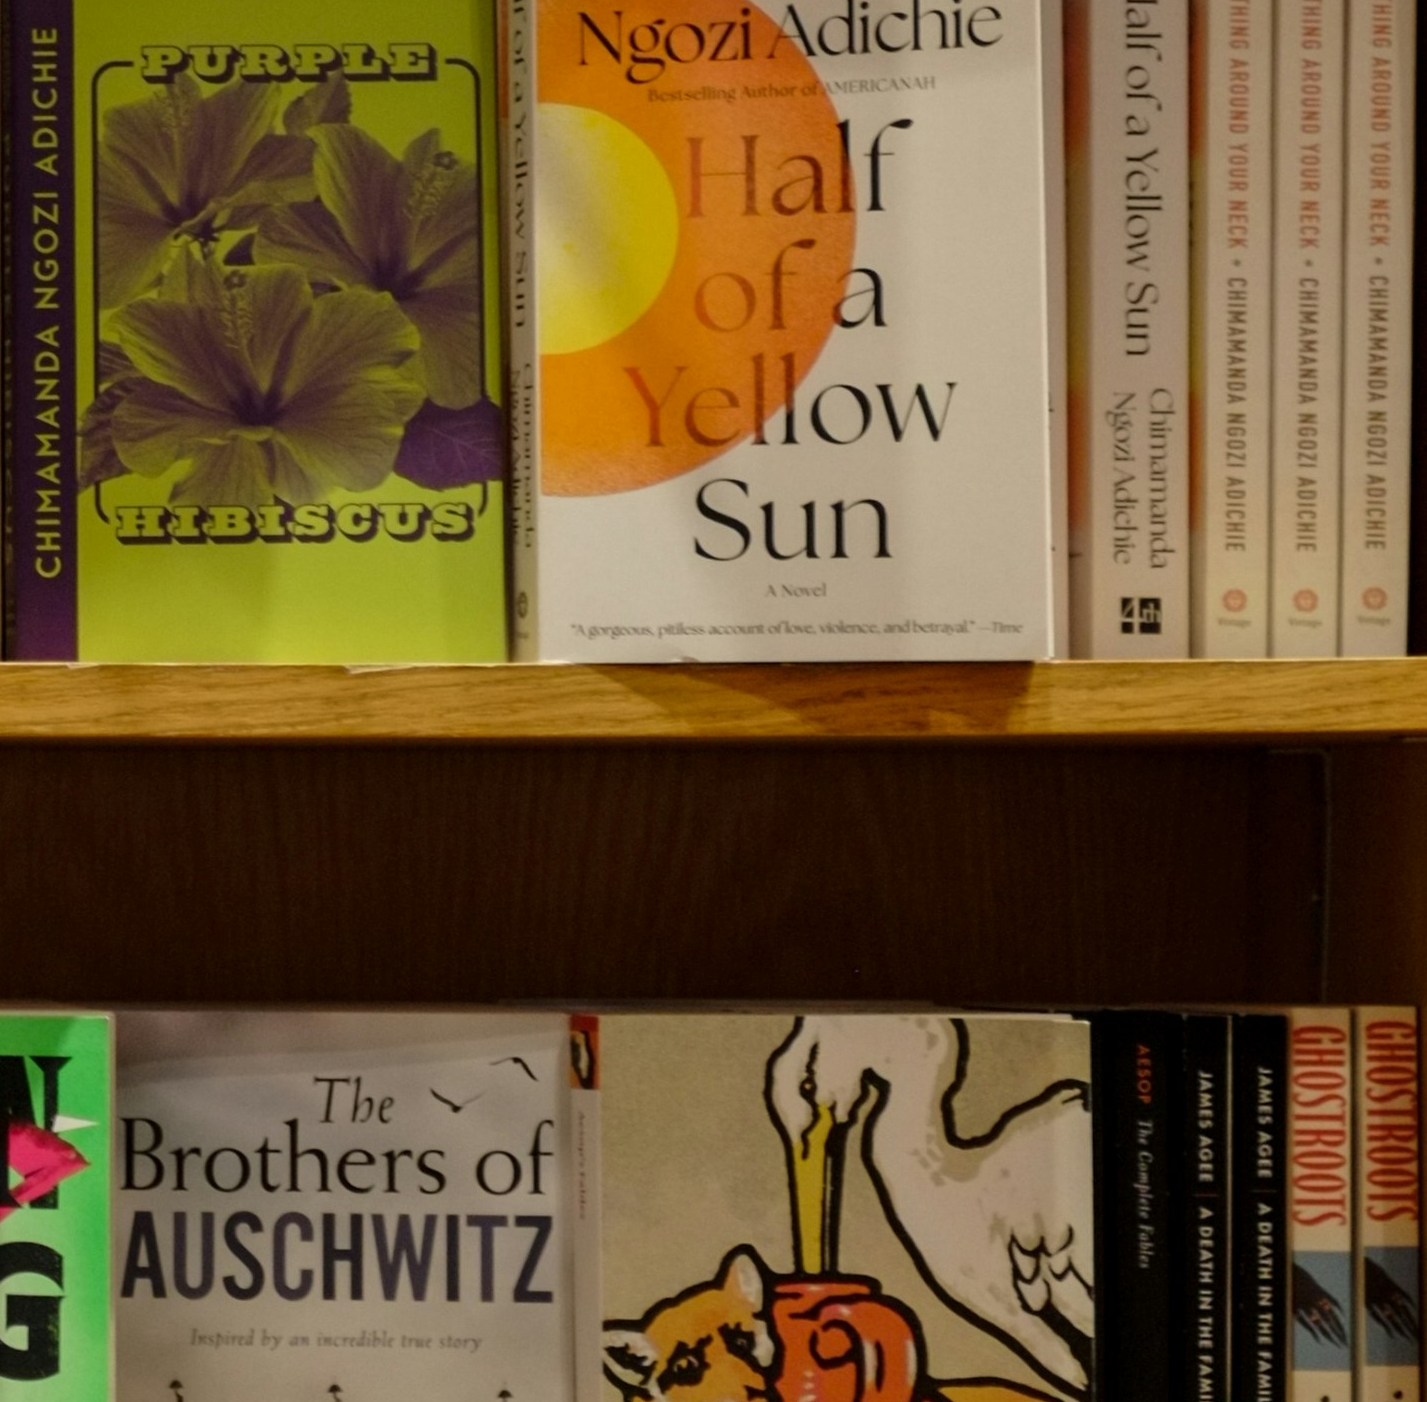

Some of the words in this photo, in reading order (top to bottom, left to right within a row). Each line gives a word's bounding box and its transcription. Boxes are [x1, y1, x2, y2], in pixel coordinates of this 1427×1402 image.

[140, 43, 440, 85] PURPLE
[577, 7, 755, 87] Ngozi
[31, 28, 59, 176] ADICHIE
[686, 118, 915, 219] Half
[32, 191, 62, 310] NGOZI
[695, 239, 817, 334] of
[833, 268, 889, 329] a
[623, 352, 960, 448] Yellow
[33, 325, 63, 579] CHIMAMANDA
[116, 502, 477, 545] HIBISCUS
[694, 478, 894, 562] Sun
[314, 1077, 396, 1124] The
[1136, 1044, 1152, 1106] AESOP
[1198, 1070, 1215, 1128] JAMES
[119, 1116, 447, 1196] Brothers
[476, 1120, 556, 1196] of
[1198, 1133, 1215, 1185] AGEE
[1293, 1024, 1348, 1229] GHOSTROOTS
[120, 1210, 554, 1304] AUSCHWITZ
